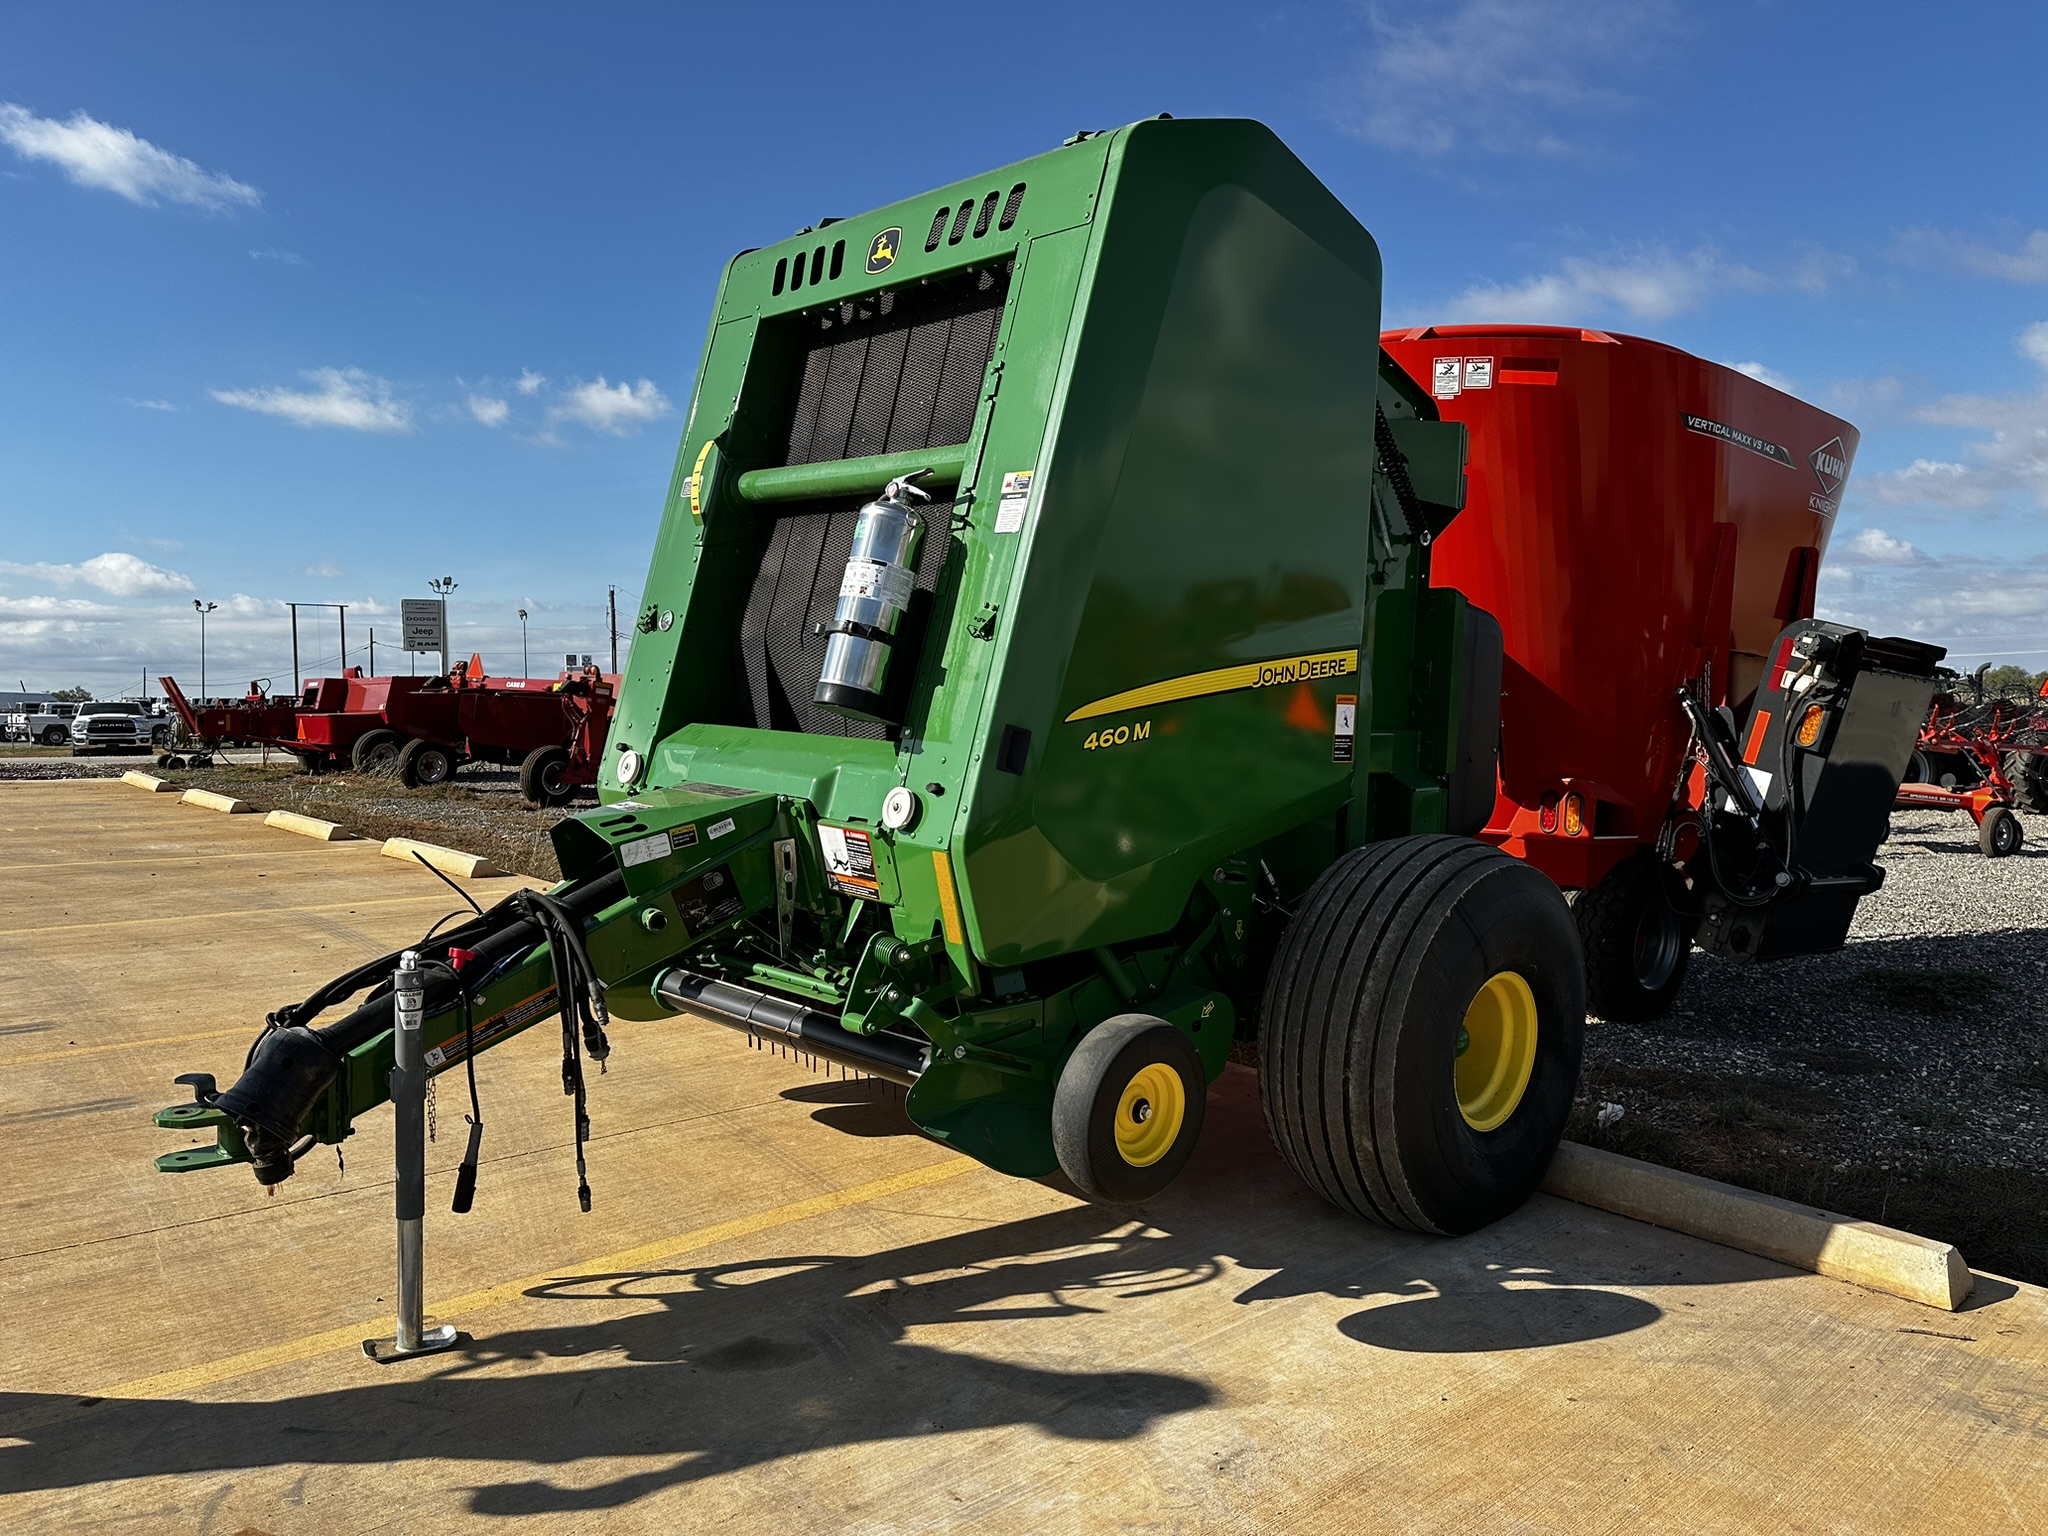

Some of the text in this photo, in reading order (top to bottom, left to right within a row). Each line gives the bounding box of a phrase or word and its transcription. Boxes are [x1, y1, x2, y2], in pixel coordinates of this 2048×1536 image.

[1687, 415, 1775, 455] VERTICAL MAXX VS 143
[1816, 451, 1846, 481] KUHN
[412, 627, 434, 636] Jeep
[1252, 658, 1348, 688] JOHN DEERE
[1083, 720, 1151, 751] 460 M
